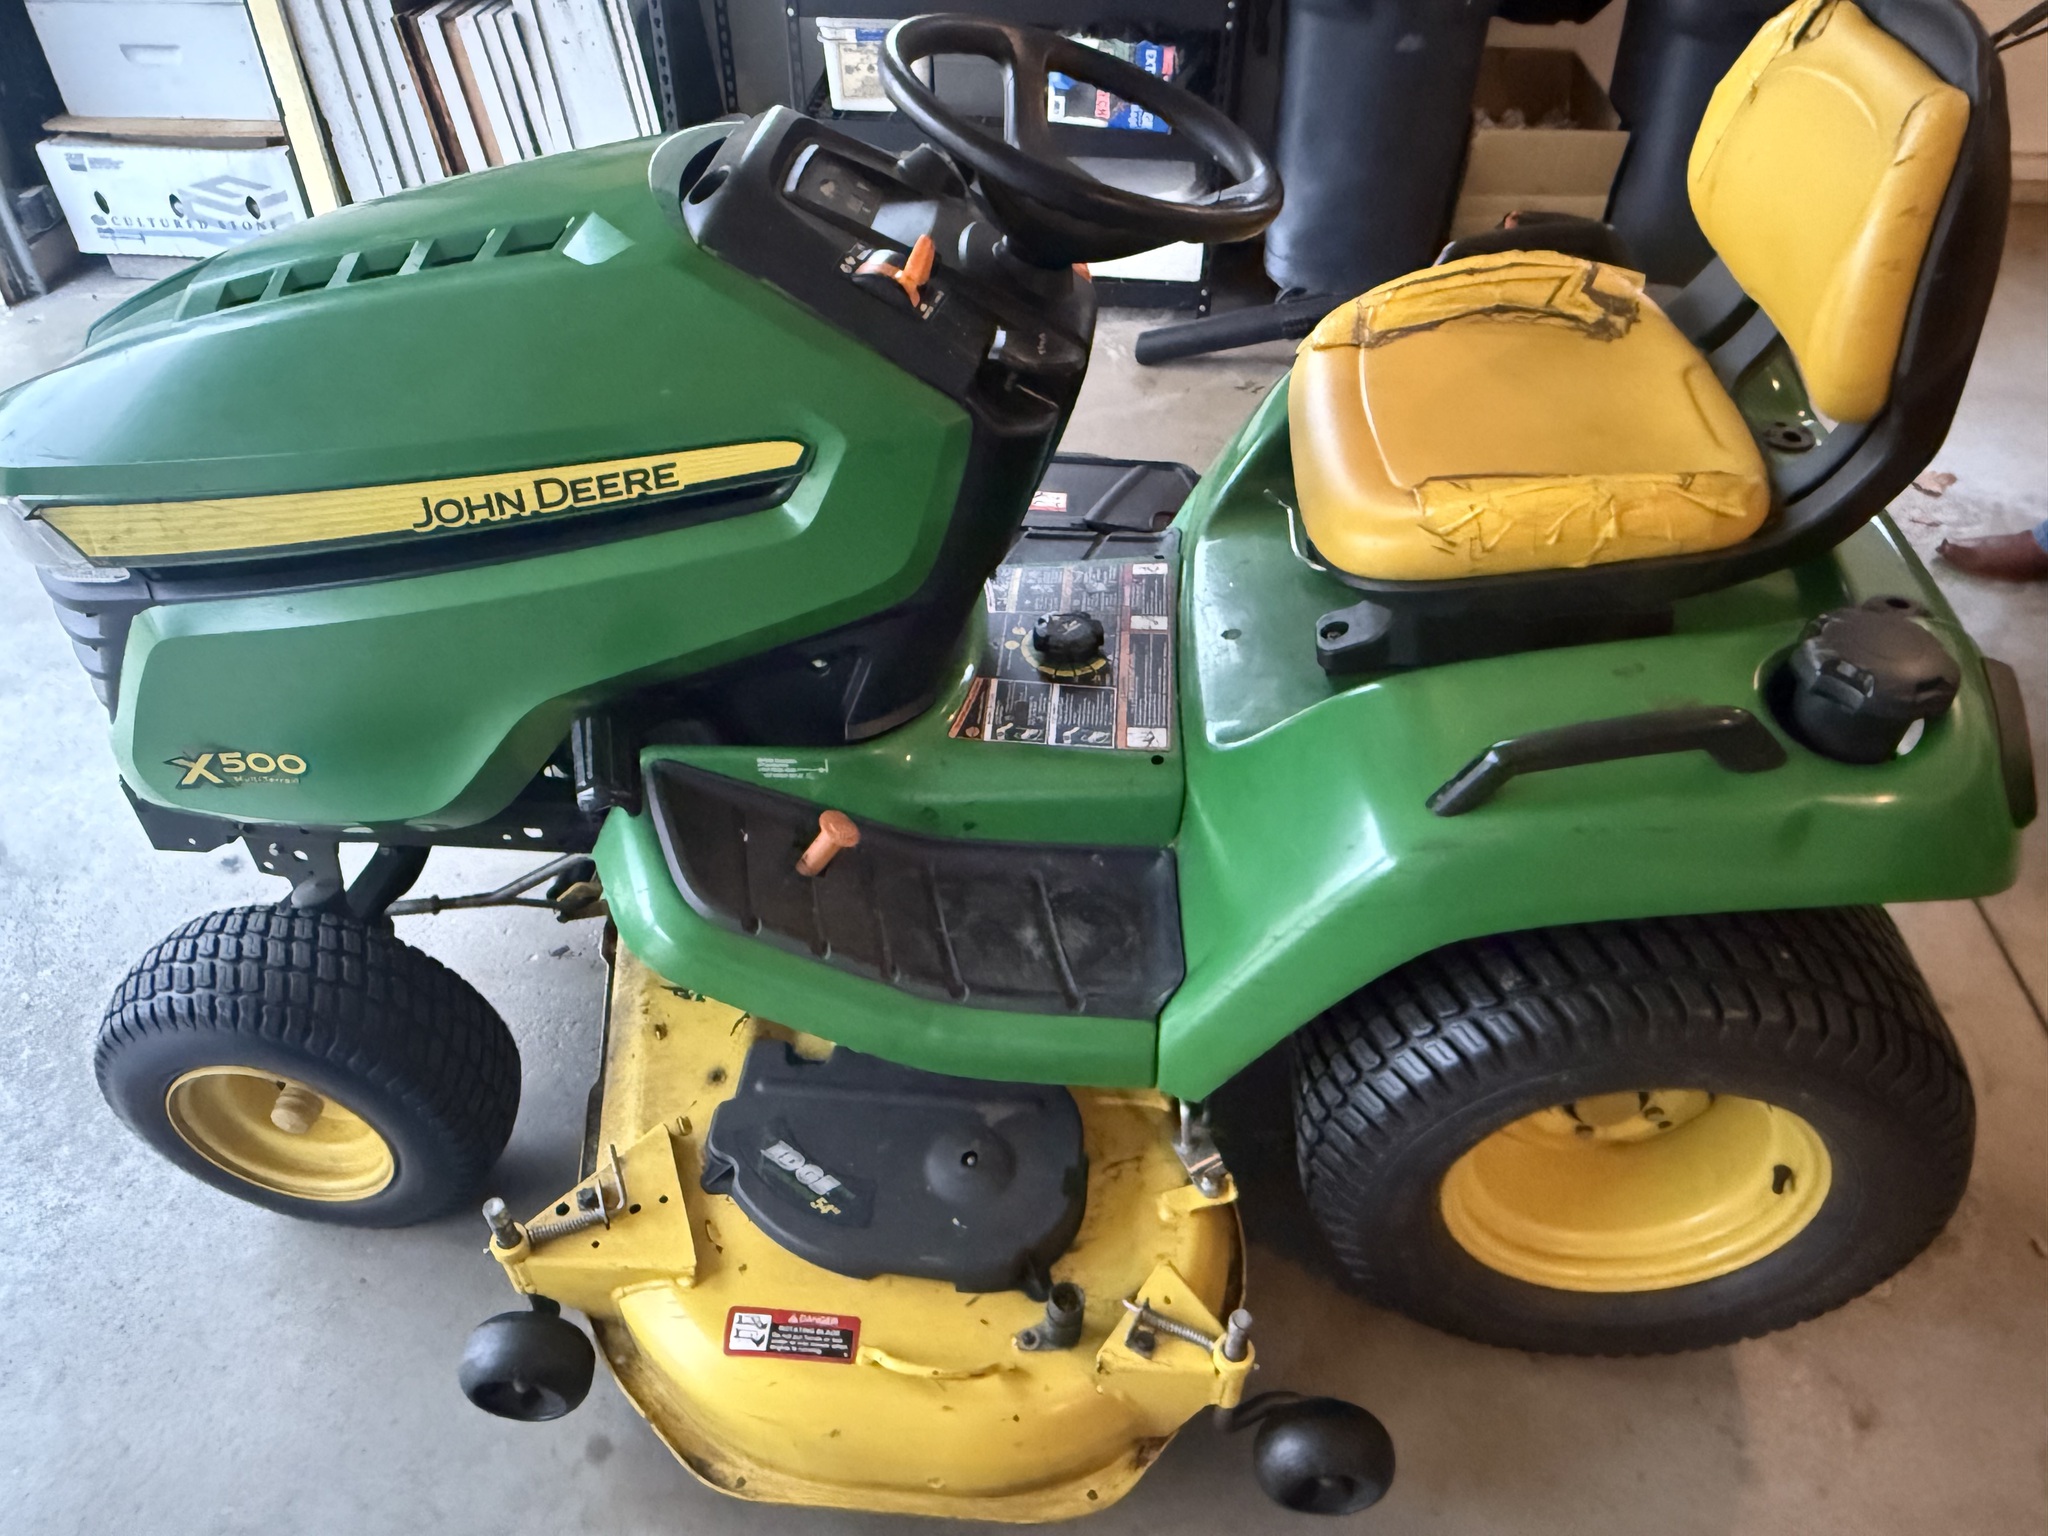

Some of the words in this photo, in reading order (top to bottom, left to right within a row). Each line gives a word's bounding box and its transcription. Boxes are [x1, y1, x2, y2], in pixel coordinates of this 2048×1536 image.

[110, 214, 209, 230] CULTURED
[413, 488, 526, 529] JOHN
[533, 462, 680, 510] DEERE
[164, 751, 308, 788] X500
[798, 1313, 839, 1326] DANGER
